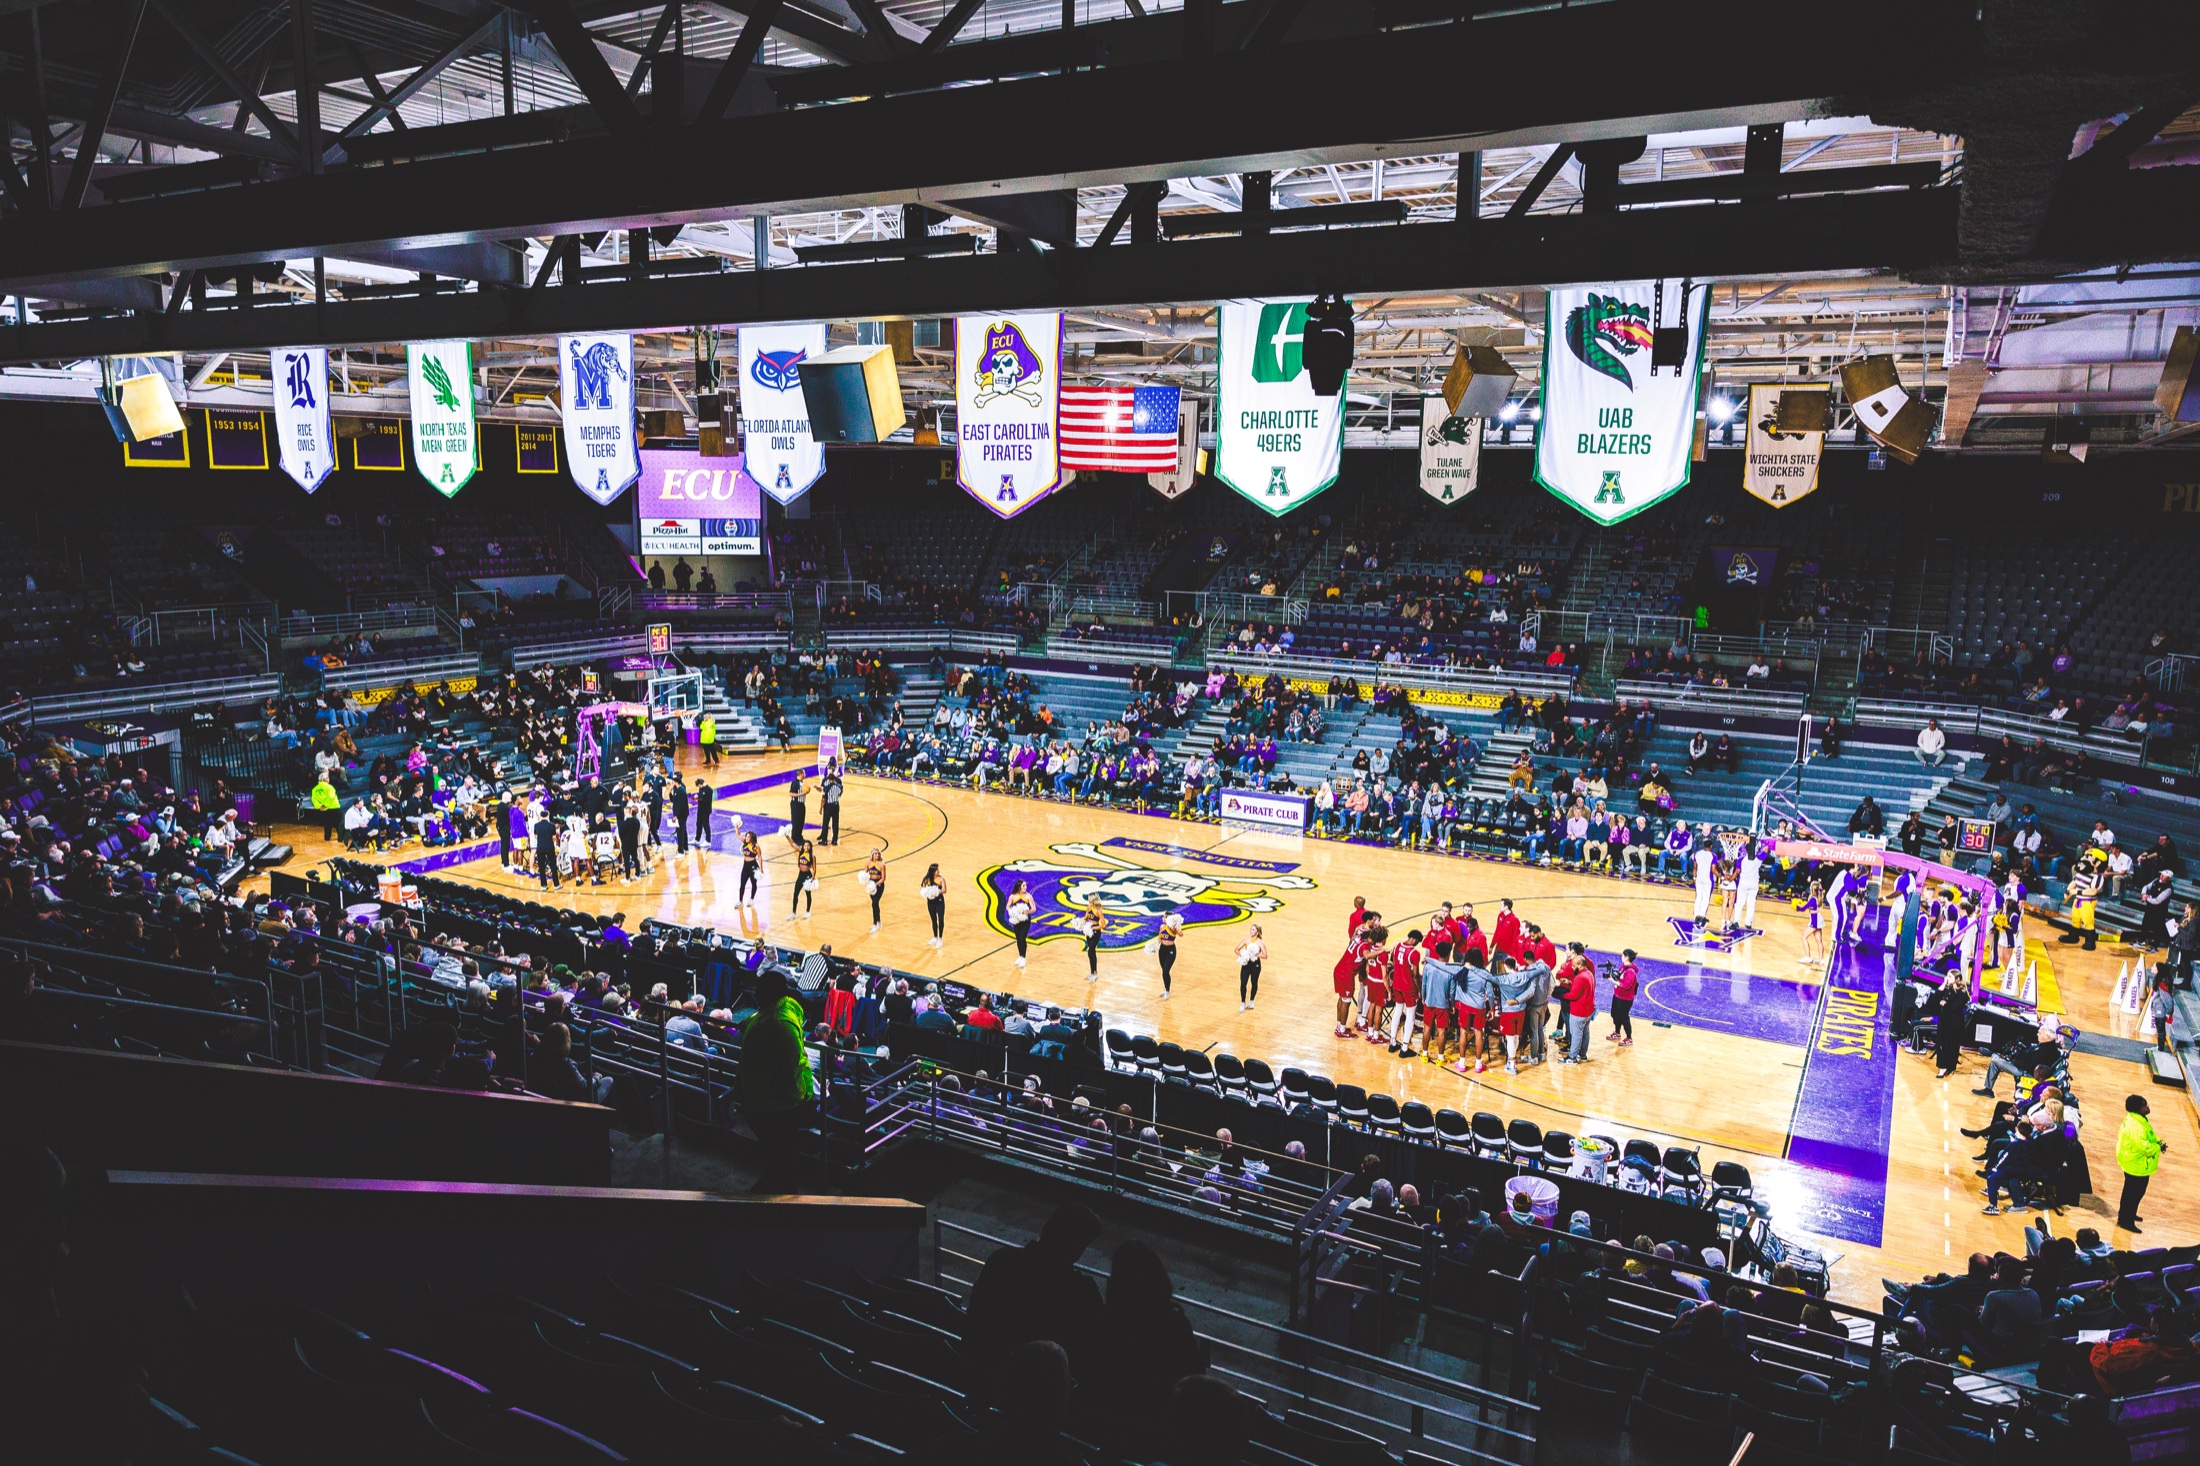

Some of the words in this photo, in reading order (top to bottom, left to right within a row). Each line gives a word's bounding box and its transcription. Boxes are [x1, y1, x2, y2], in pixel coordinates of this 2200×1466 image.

[992, 334, 1014, 350] ECU
[214, 420, 234, 430] 1953
[238, 421, 259, 430] 1954
[1241, 410, 1318, 429] CHARLOTTE
[1598, 408, 1633, 428] UAB
[298, 424, 312, 436] RICE
[379, 426, 398, 434] 1993
[420, 423, 444, 436] NORTH
[446, 422, 467, 436] TEXAS
[580, 426, 620, 440] MEMPHIS
[744, 420, 780, 433] FLORIDA
[963, 424, 990, 441] EAST
[994, 423, 1050, 441] CAROLINA
[521, 433, 535, 441] 2011
[771, 436, 795, 450] OWLS
[1257, 434, 1301, 452] 49ERS
[1578, 434, 1651, 454] BLAZERS
[298, 439, 316, 452] OWLS
[422, 439, 442, 453] MEAN
[446, 439, 467, 452] GREEN
[586, 444, 616, 457] TIGERS
[983, 445, 1032, 461] PIRATES
[1750, 455, 1788, 465] WICHITA
[1790, 454, 1816, 465] STATE
[1437, 458, 1462, 467] TULANE
[1427, 469, 1449, 478] GREEN
[1451, 469, 1470, 478] WAVE
[1758, 466, 1804, 477] SHOCKERS
[658, 469, 740, 501] ECU
[2043, 493, 2060, 501] 209
[651, 636, 668, 652] 30
[1243, 805, 1273, 817] PIRATE
[1276, 809, 1298, 820] CLUB
[600, 837, 610, 845] 12
[1125, 840, 1176, 852] ARENA
[1966, 834, 1984, 847] 30
[1182, 850, 1275, 869] WILLIAMS
[1822, 848, 1849, 860] State
[1850, 851, 1876, 863] Farm
[1398, 952, 1404, 964] 4
[2022, 978, 2031, 999] PIRATES
[1816, 986, 1878, 1060] PIRATES
